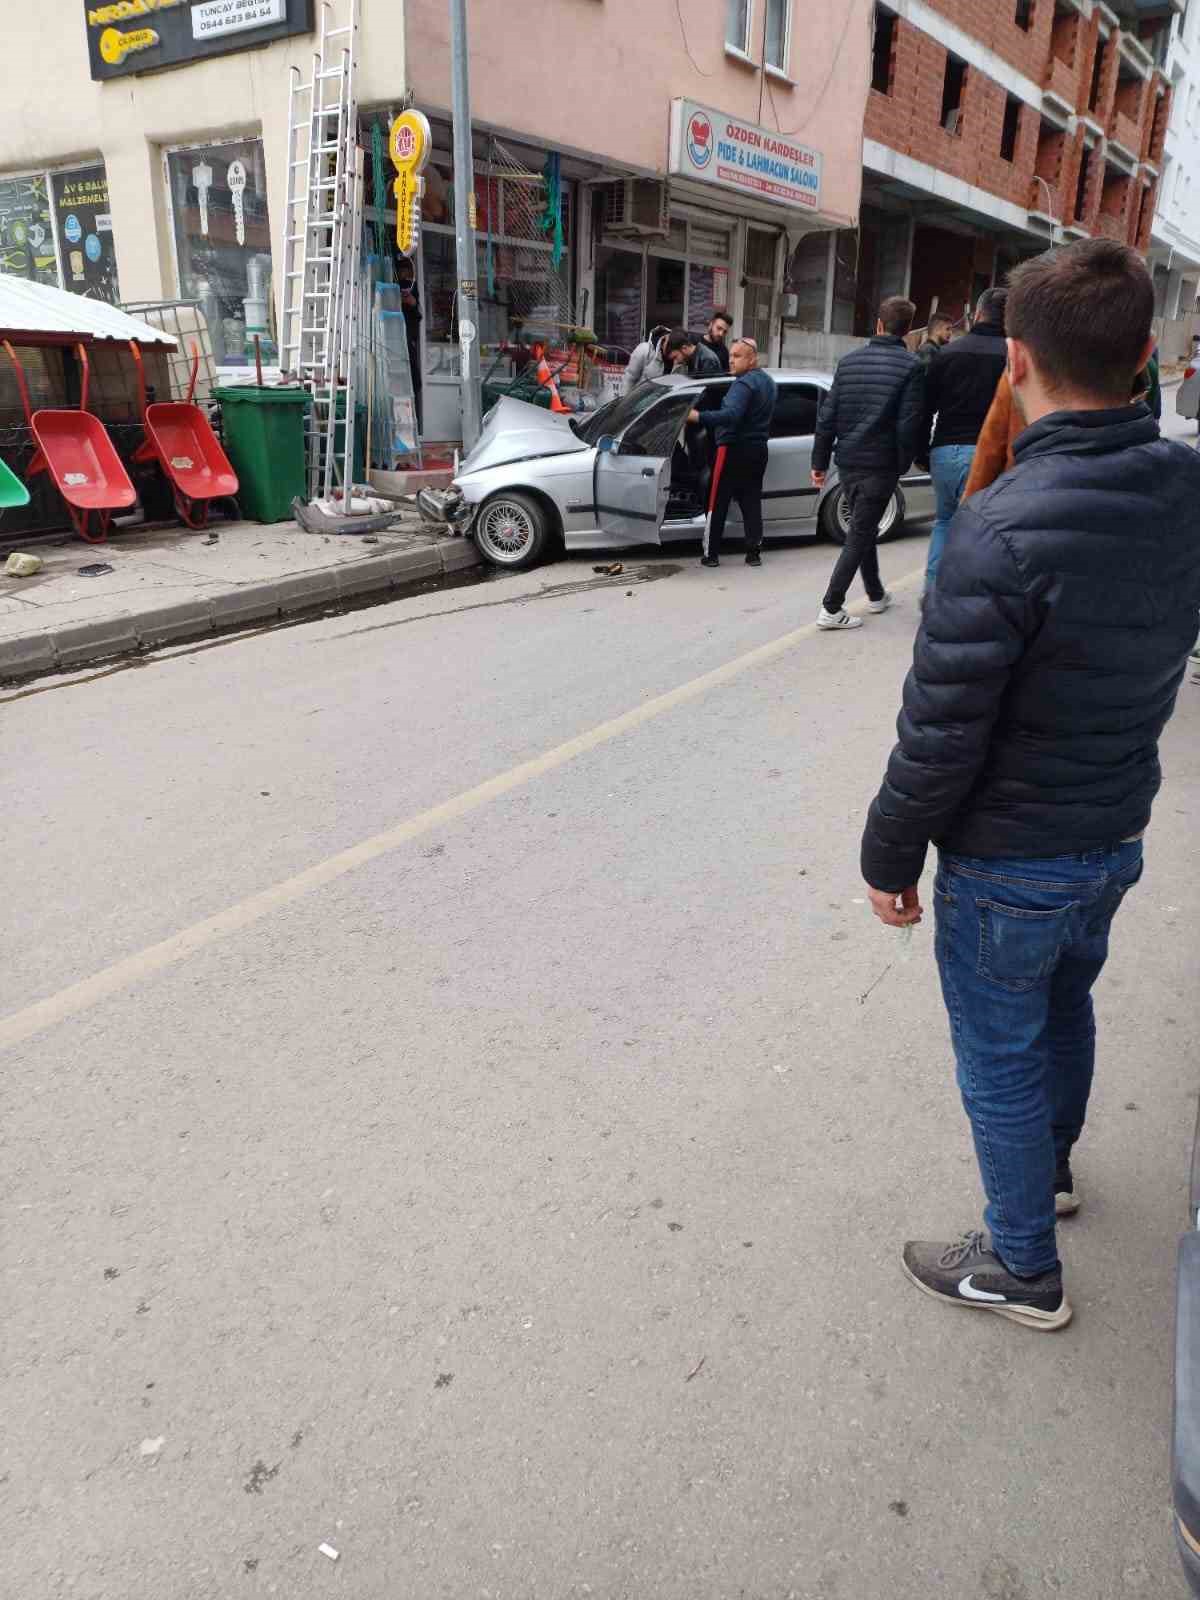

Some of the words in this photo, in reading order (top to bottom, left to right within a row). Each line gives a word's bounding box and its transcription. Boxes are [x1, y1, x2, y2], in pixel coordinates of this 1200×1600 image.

[200, 3, 233, 18] TUNCAY
[762, 136, 815, 167] KARDEŞLER
[746, 151, 790, 179] LAHMACUN
[790, 166, 818, 190] SALONU
